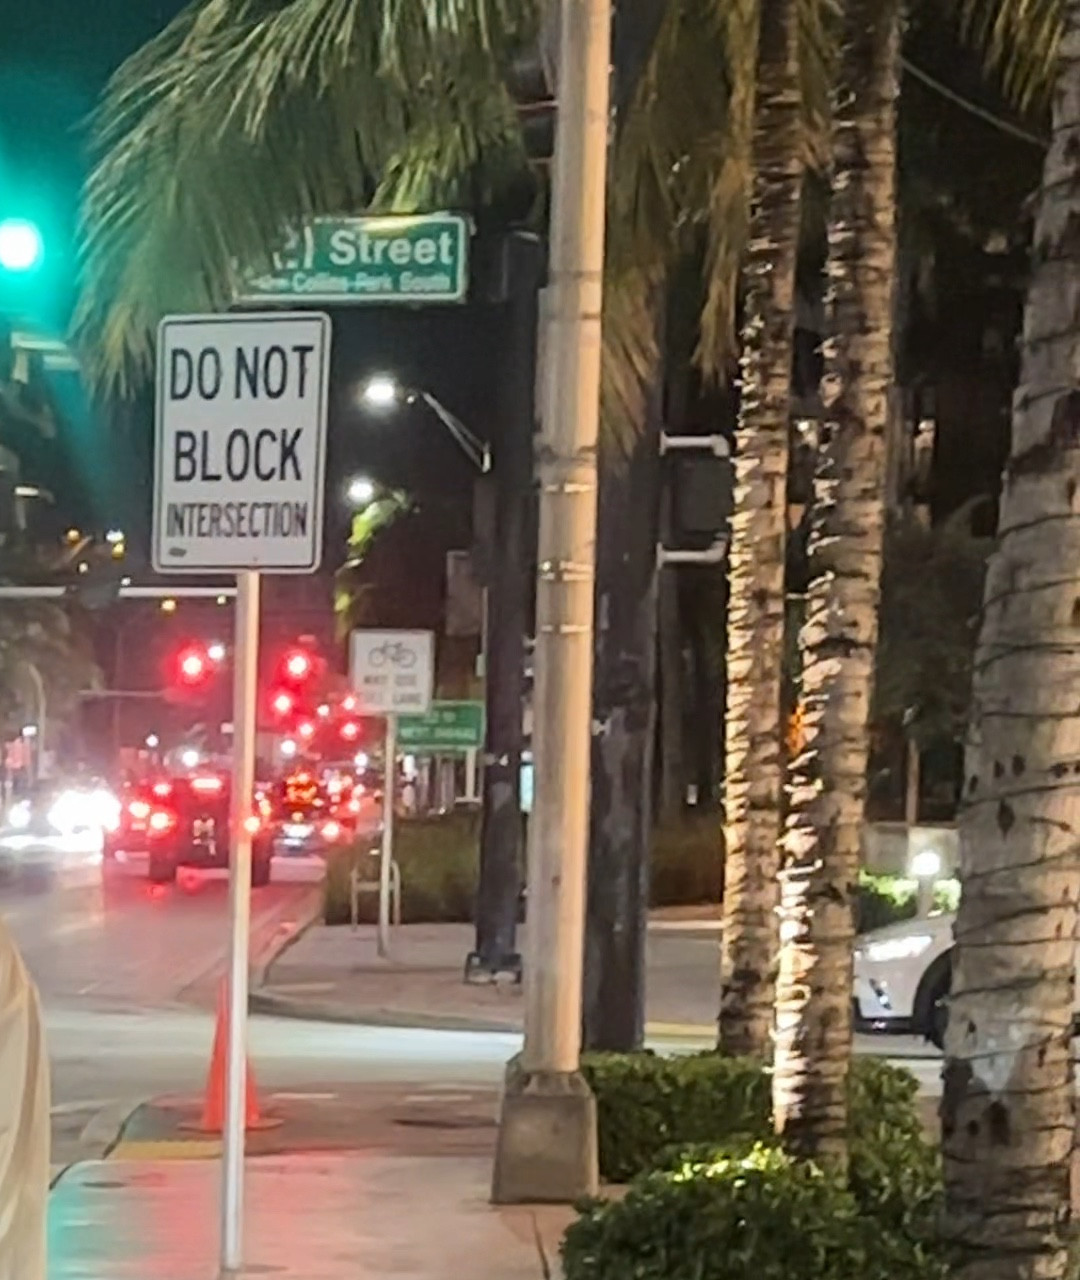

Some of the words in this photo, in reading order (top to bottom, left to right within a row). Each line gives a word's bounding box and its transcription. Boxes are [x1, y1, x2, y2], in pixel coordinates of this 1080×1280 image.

[329, 229, 453, 266] Street
[171, 346, 222, 400] DO
[234, 345, 314, 399] NOT
[174, 428, 303, 482] BLOCK
[166, 502, 308, 537] INTERSECTION
